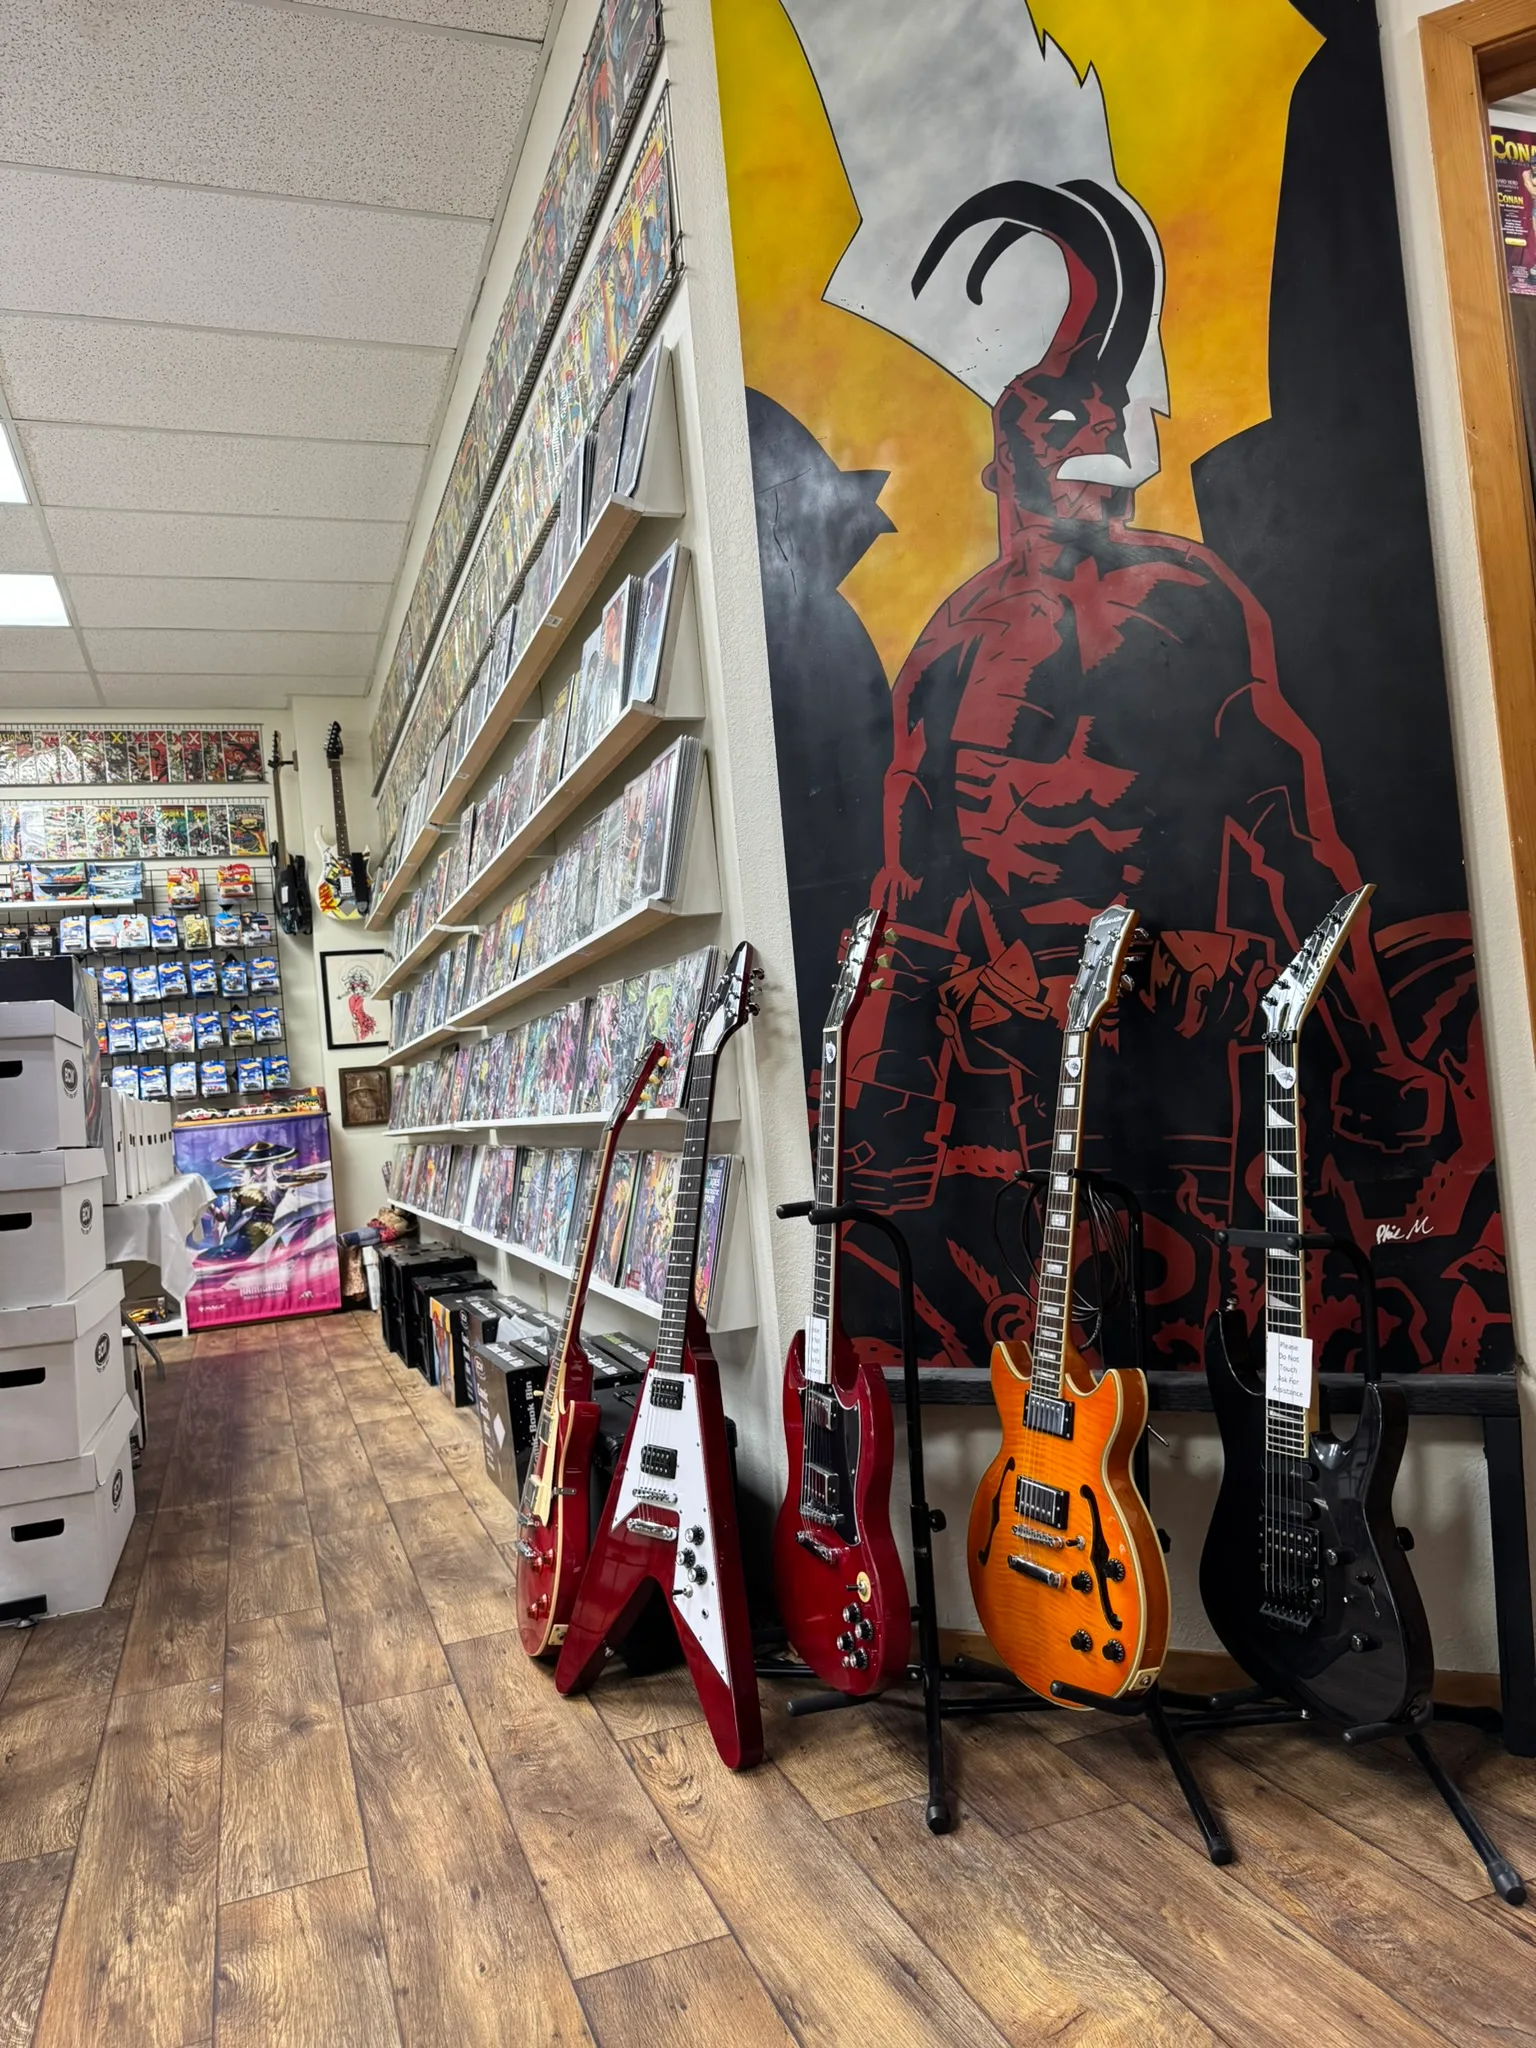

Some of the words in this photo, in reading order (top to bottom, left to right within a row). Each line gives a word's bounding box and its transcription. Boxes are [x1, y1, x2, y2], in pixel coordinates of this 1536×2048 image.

[1497, 193, 1524, 205] CONAN
[1301, 922, 1340, 1002] Jackson
[1279, 1341, 1299, 1352] Please
[1279, 1353, 1287, 1361] Do
[1287, 1354, 1300, 1363] Not
[1280, 1364, 1298, 1375] Touch
[1277, 1375, 1289, 1384] Ask
[1288, 1377, 1300, 1386] For
[525, 1380, 534, 1401] Bin
[1272, 1385, 1304, 1398] Assistance
[527, 1402, 537, 1433] Book
